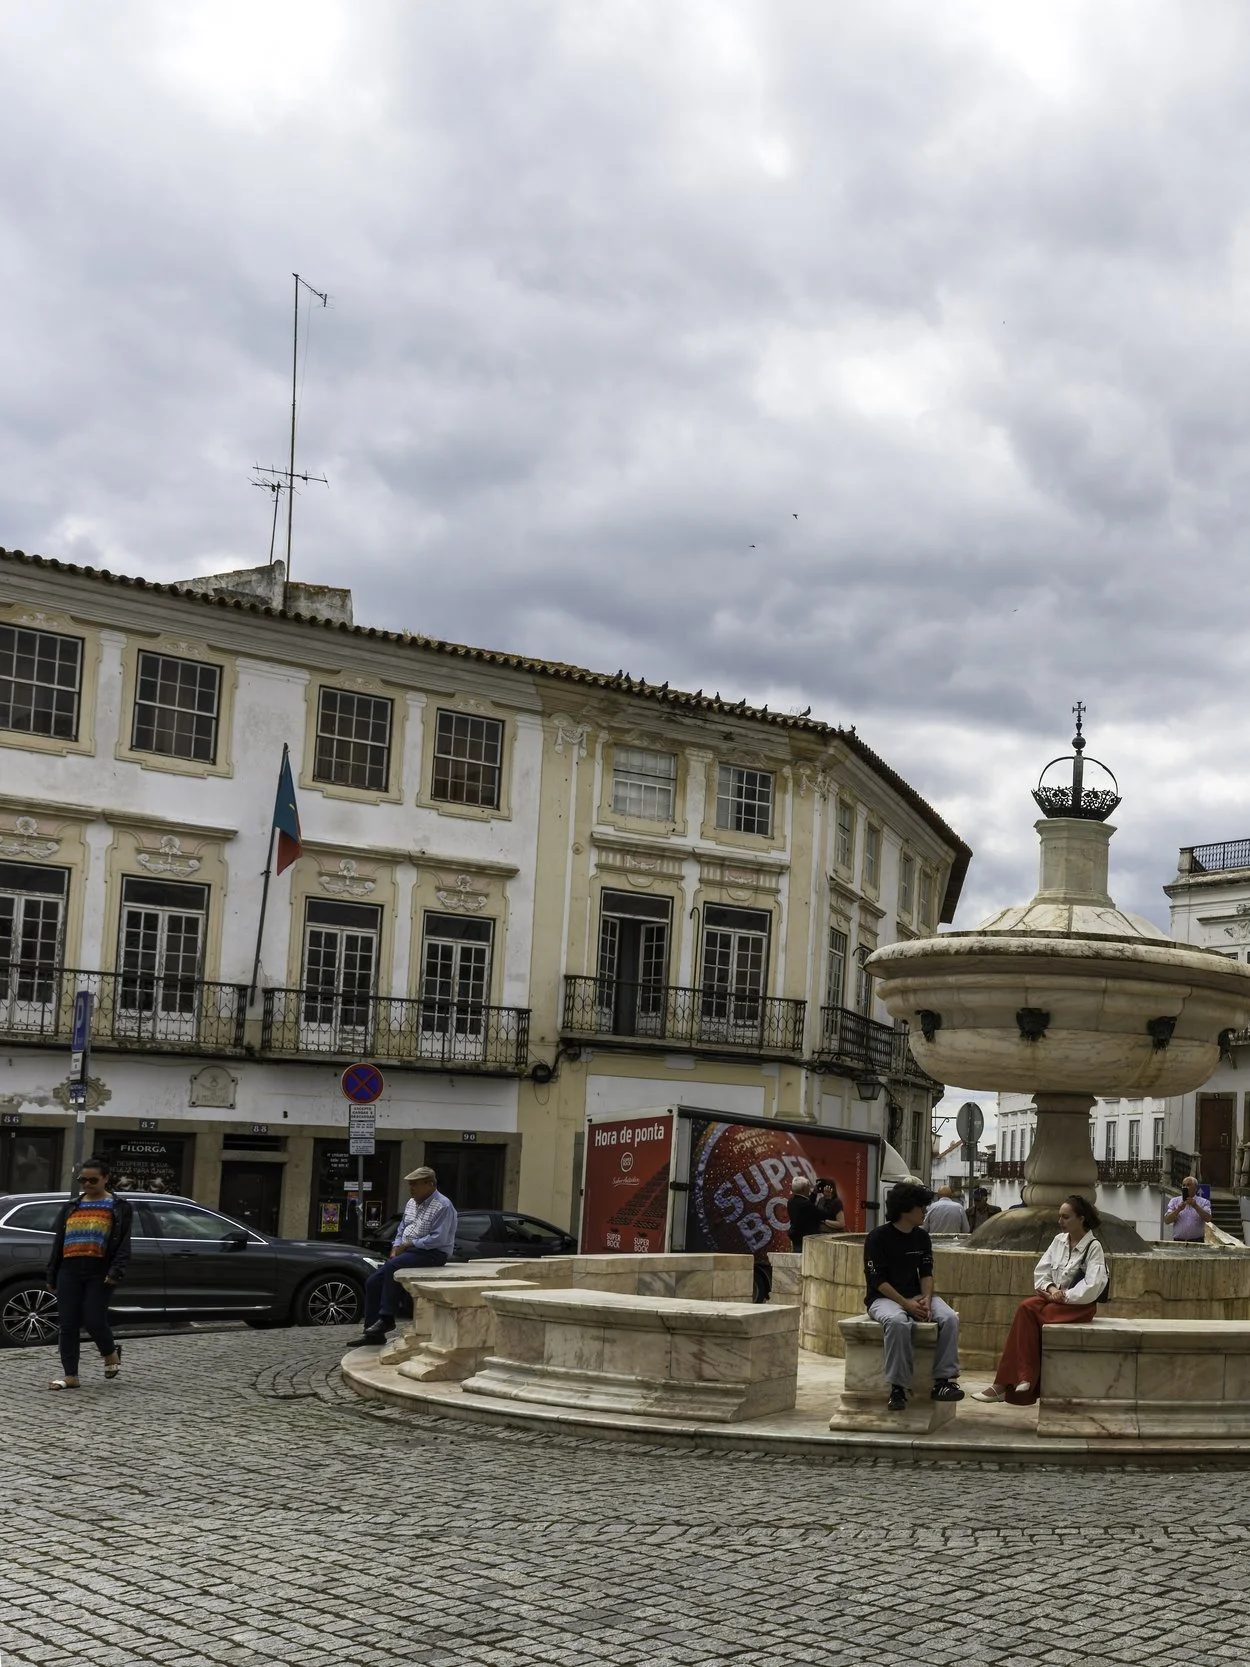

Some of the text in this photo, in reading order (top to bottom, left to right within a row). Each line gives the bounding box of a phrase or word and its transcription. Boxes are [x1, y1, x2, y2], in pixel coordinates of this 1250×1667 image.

[4, 1115, 20, 1124] 86
[141, 1121, 156, 1129] 87
[253, 1125, 268, 1133] 88
[463, 1133, 476, 1141] 90
[595, 1122, 665, 1148] Hora de ponta
[120, 1145, 167, 1153] FILORGA
[606, 1233, 621, 1242] SUPER
[606, 1240, 620, 1249] BOCK
[633, 1237, 650, 1247] SUPER
[633, 1245, 649, 1253] BOCK
